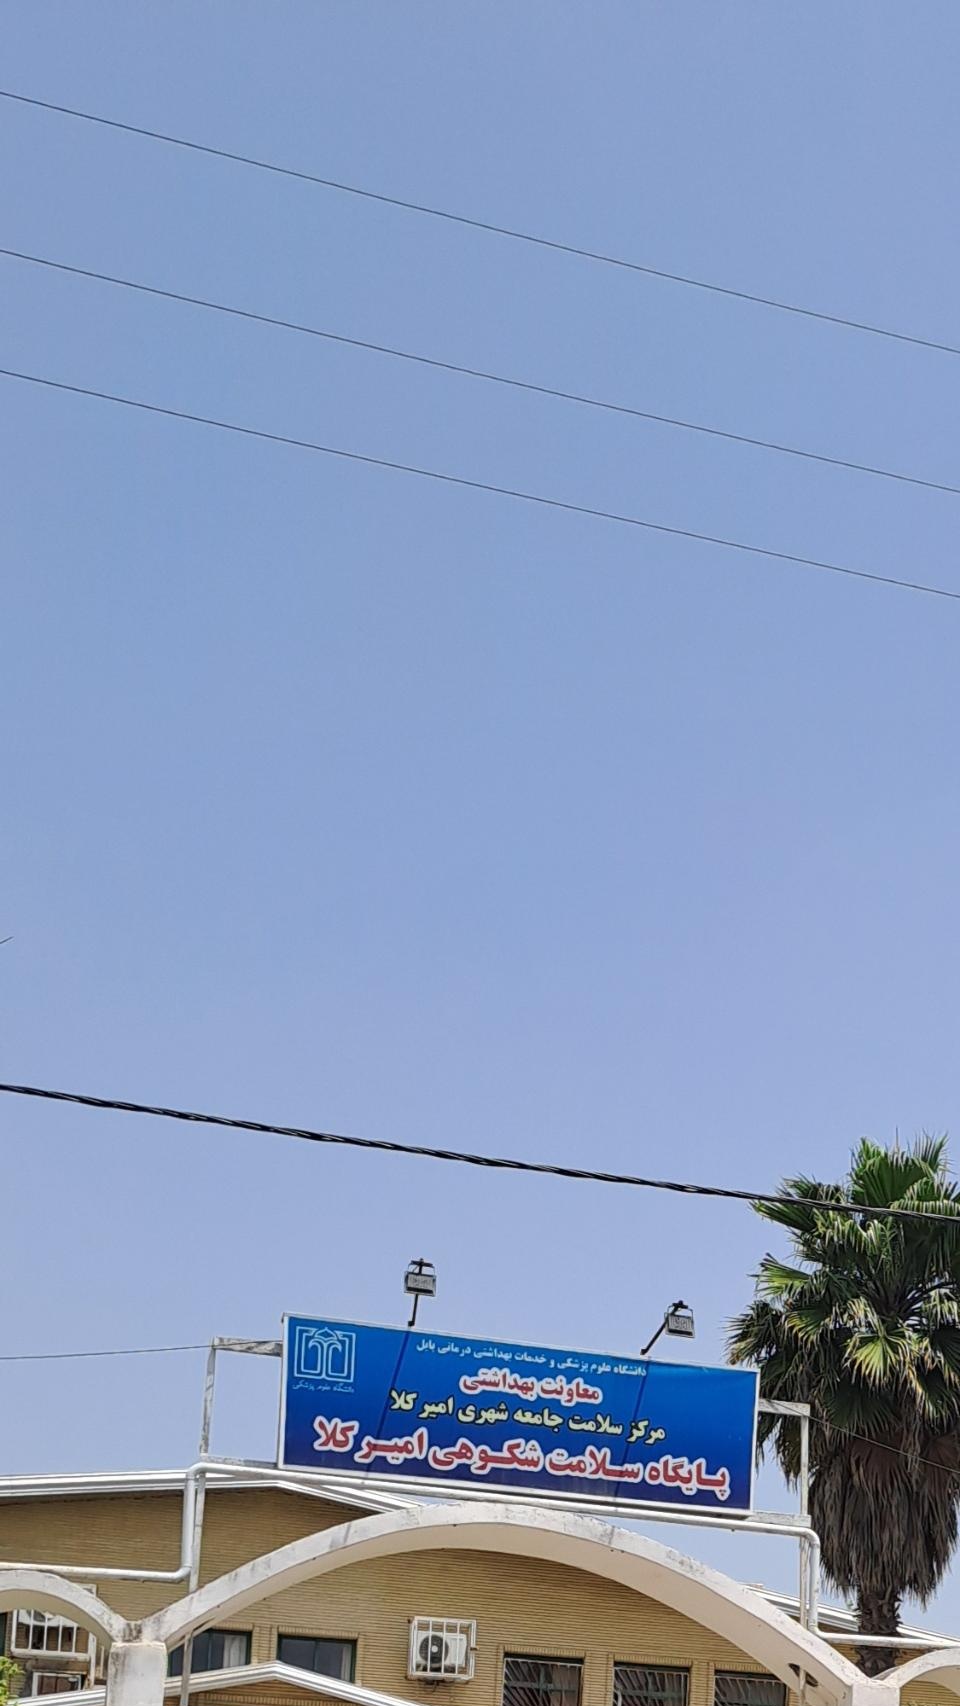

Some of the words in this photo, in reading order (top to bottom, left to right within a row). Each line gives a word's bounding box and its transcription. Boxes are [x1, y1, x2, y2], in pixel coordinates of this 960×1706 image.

[416, 1339, 435, 1353] بابل
[437, 1341, 471, 1356] درمانی
[473, 1346, 513, 1361] بهداشتی
[514, 1351, 547, 1364] خدمات
[557, 1357, 588, 1372] پزشکی
[590, 1361, 612, 1375] علوم
[613, 1363, 647, 1376] دانشگاه
[461, 1369, 536, 1399] بهداشتی
[540, 1376, 601, 1404] معاونت
[458, 1402, 508, 1424] شهری
[513, 1408, 563, 1432] جامعه
[568, 1413, 623, 1435] سلامت
[626, 1420, 666, 1444] مرکز
[356, 1428, 426, 1462] امیر
[430, 1440, 542, 1472] شکوهی
[548, 1447, 642, 1481] سلامت
[647, 1456, 728, 1498] پایگاه
